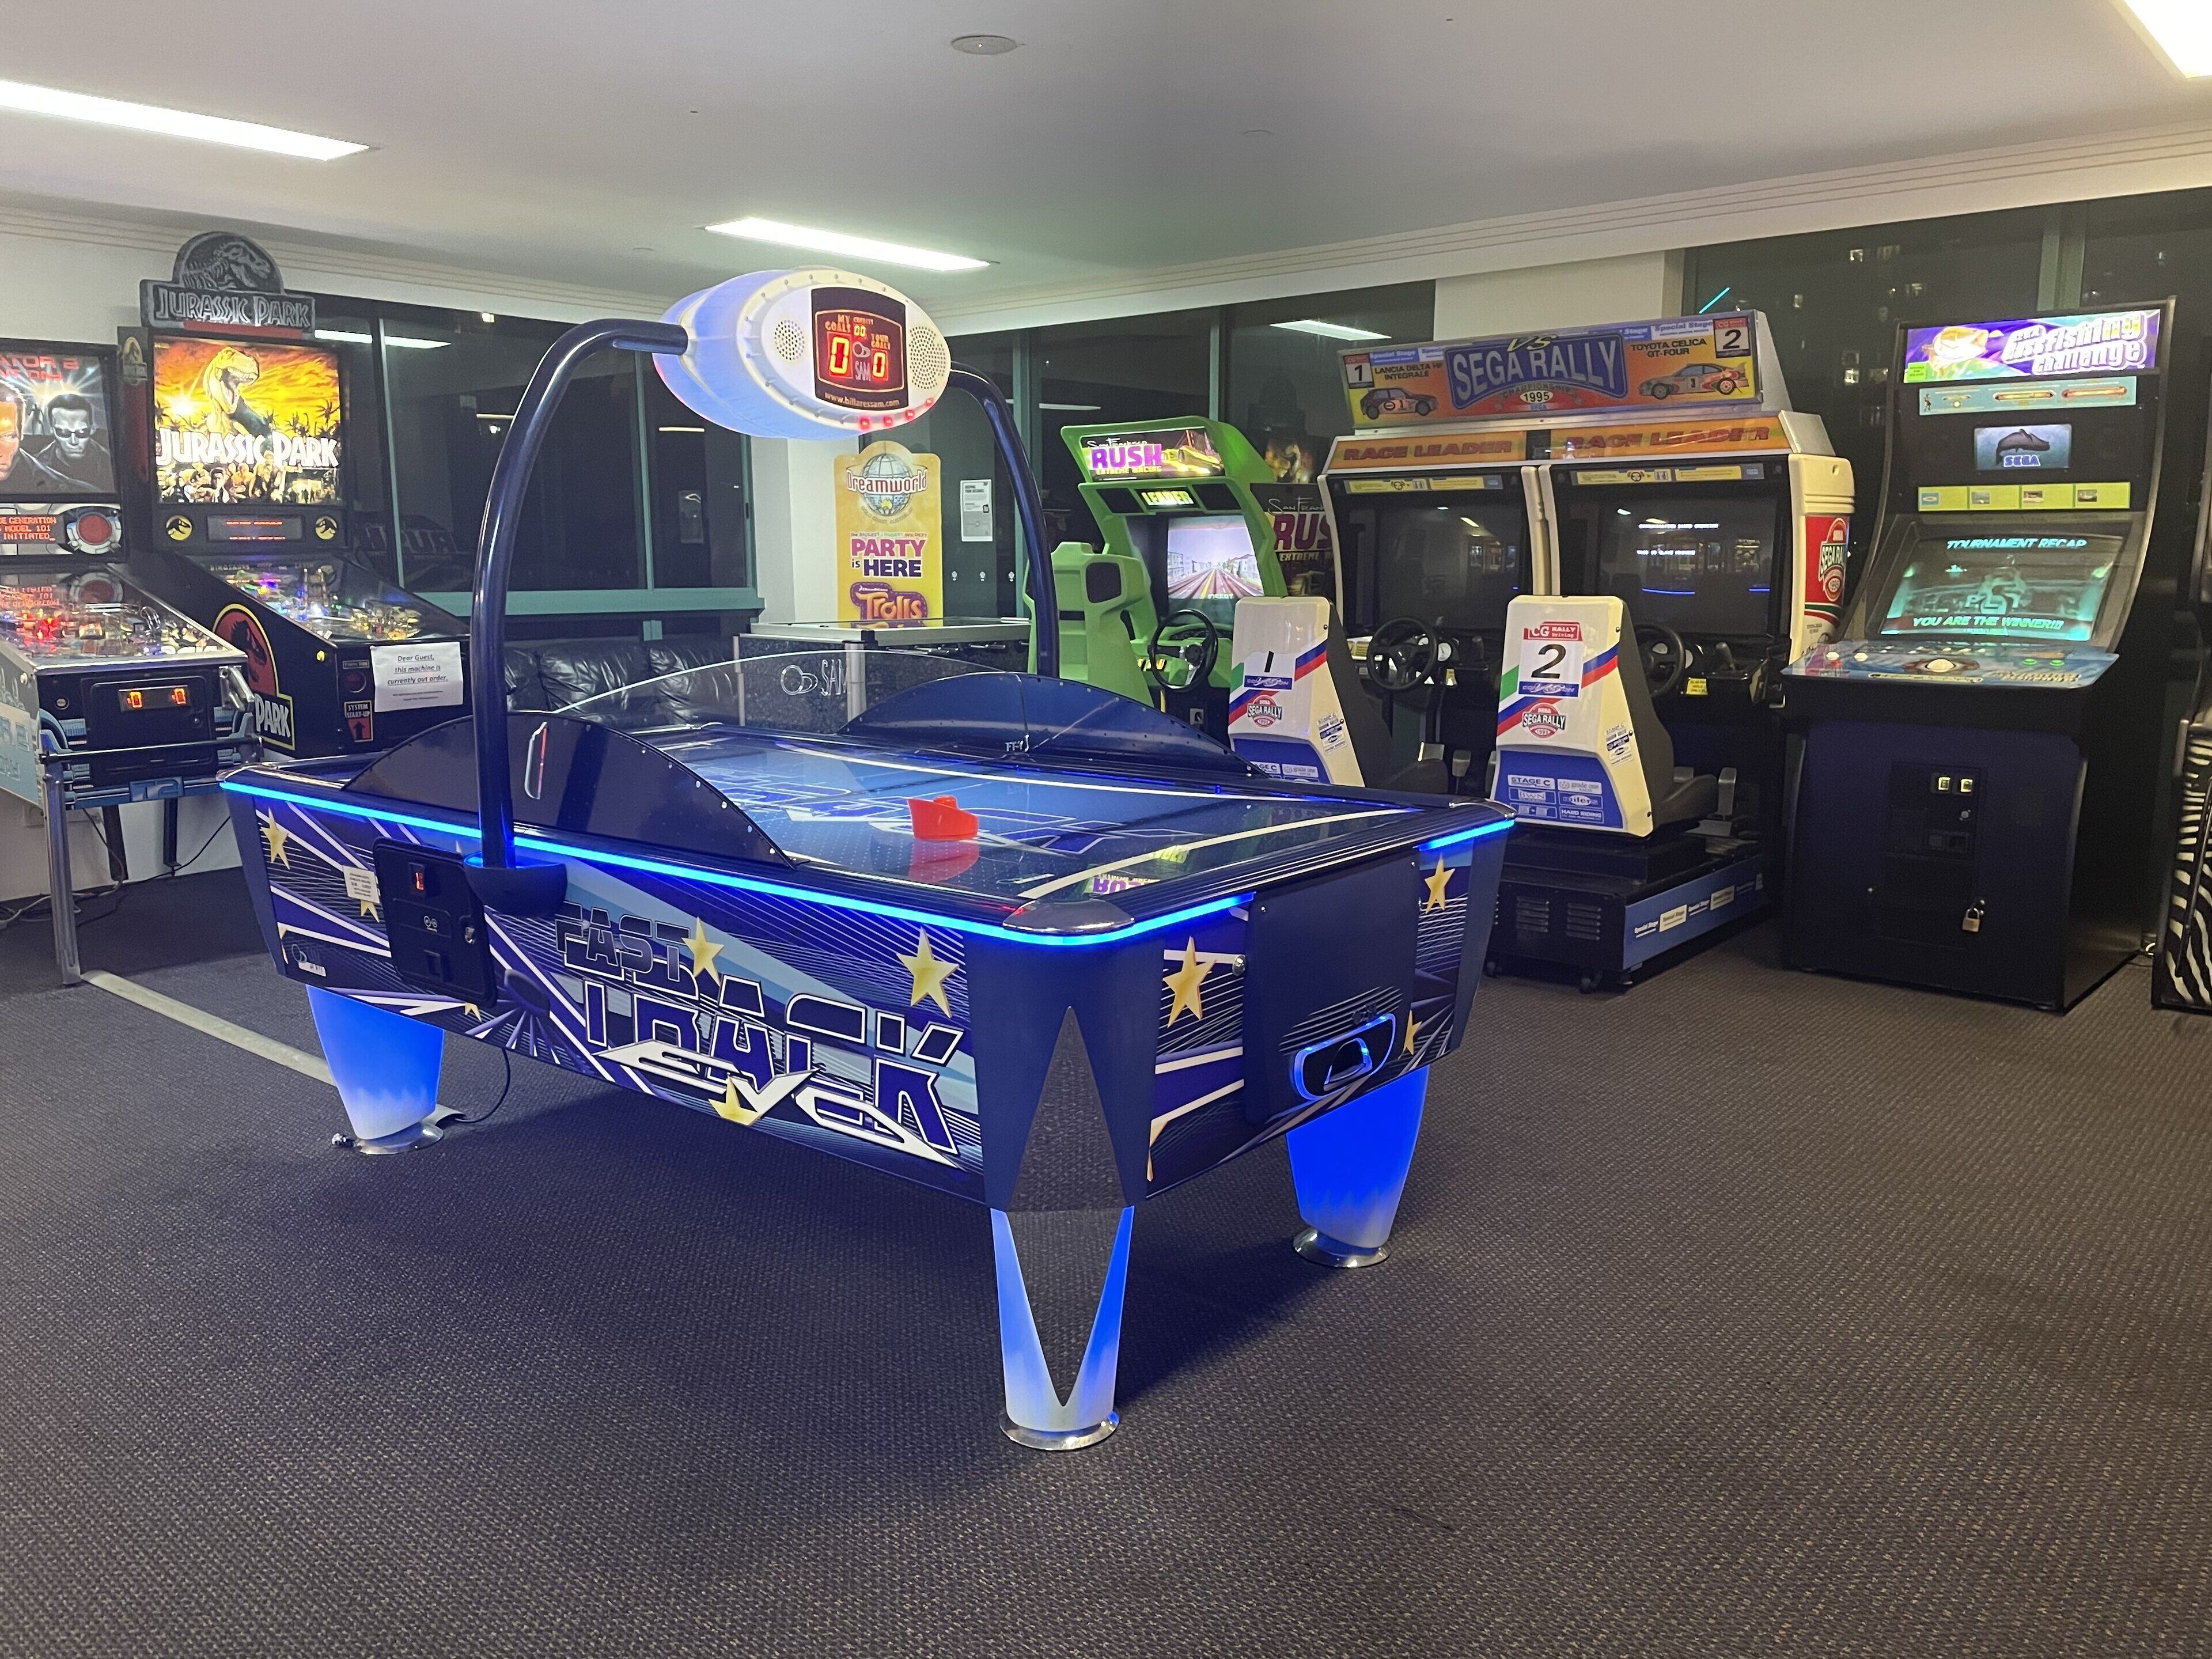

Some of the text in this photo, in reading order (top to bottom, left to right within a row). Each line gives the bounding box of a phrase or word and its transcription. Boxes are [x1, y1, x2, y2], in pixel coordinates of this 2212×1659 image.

[156, 287, 311, 327] JURASSIC PARK
[824, 320, 851, 333] GOALS
[838, 314, 850, 323] MY
[854, 324, 866, 338] 00
[871, 333, 889, 342] YOUR
[1506, 334, 1559, 352] VS
[1631, 338, 1707, 351] TOYOTA CELICA
[1722, 329, 1741, 350] 2
[830, 336, 850, 375] 0
[1647, 347, 1690, 358] GT-FOUR
[63, 358, 79, 370] 2
[855, 360, 871, 381] SAM
[872, 351, 886, 378] 0
[1374, 364, 1404, 374] LANCIA
[1406, 363, 1431, 372] DELTA
[1453, 340, 1616, 400] SEGA RALLY
[1354, 365, 1363, 381] 1
[1384, 370, 1430, 381] INTEGRALE
[1502, 382, 1571, 399] CHAMPIONSHIP
[1523, 392, 1550, 403] 1995
[1565, 426, 1770, 449] RACE LEADER
[156, 426, 339, 469] JURASSIC PARK
[1343, 441, 1512, 461] RACE LEADER
[1091, 444, 1162, 469] RUSH
[2003, 454, 2041, 468] SEGA
[847, 469, 927, 493] Dreamworld
[1141, 490, 1194, 506] LEADER
[1273, 513, 1332, 551] RUS
[851, 538, 926, 557] PARTY
[1946, 537, 2087, 550] TOURNAMENT RECAP
[1279, 552, 1320, 562] EXTREME
[852, 558, 922, 577] is HERE
[855, 591, 923, 620] Trolls
[1913, 616, 1942, 627] YOU
[1943, 616, 1971, 626] ARE
[1973, 616, 1999, 626] THE
[1531, 626, 1550, 637] CG
[408, 664, 434, 672] machine
[1264, 650, 1274, 673] 1
[1531, 643, 1566, 679] 2
[387, 676, 416, 685] currently
[348, 703, 369, 711] SYSTEM
[1248, 704, 1283, 719] SEGA RALLY
[254, 693, 291, 738] PARK
[1523, 714, 1566, 730] SEGA RALLY
[1511, 777, 1541, 785] STAGE
[554, 899, 692, 983] FAST
